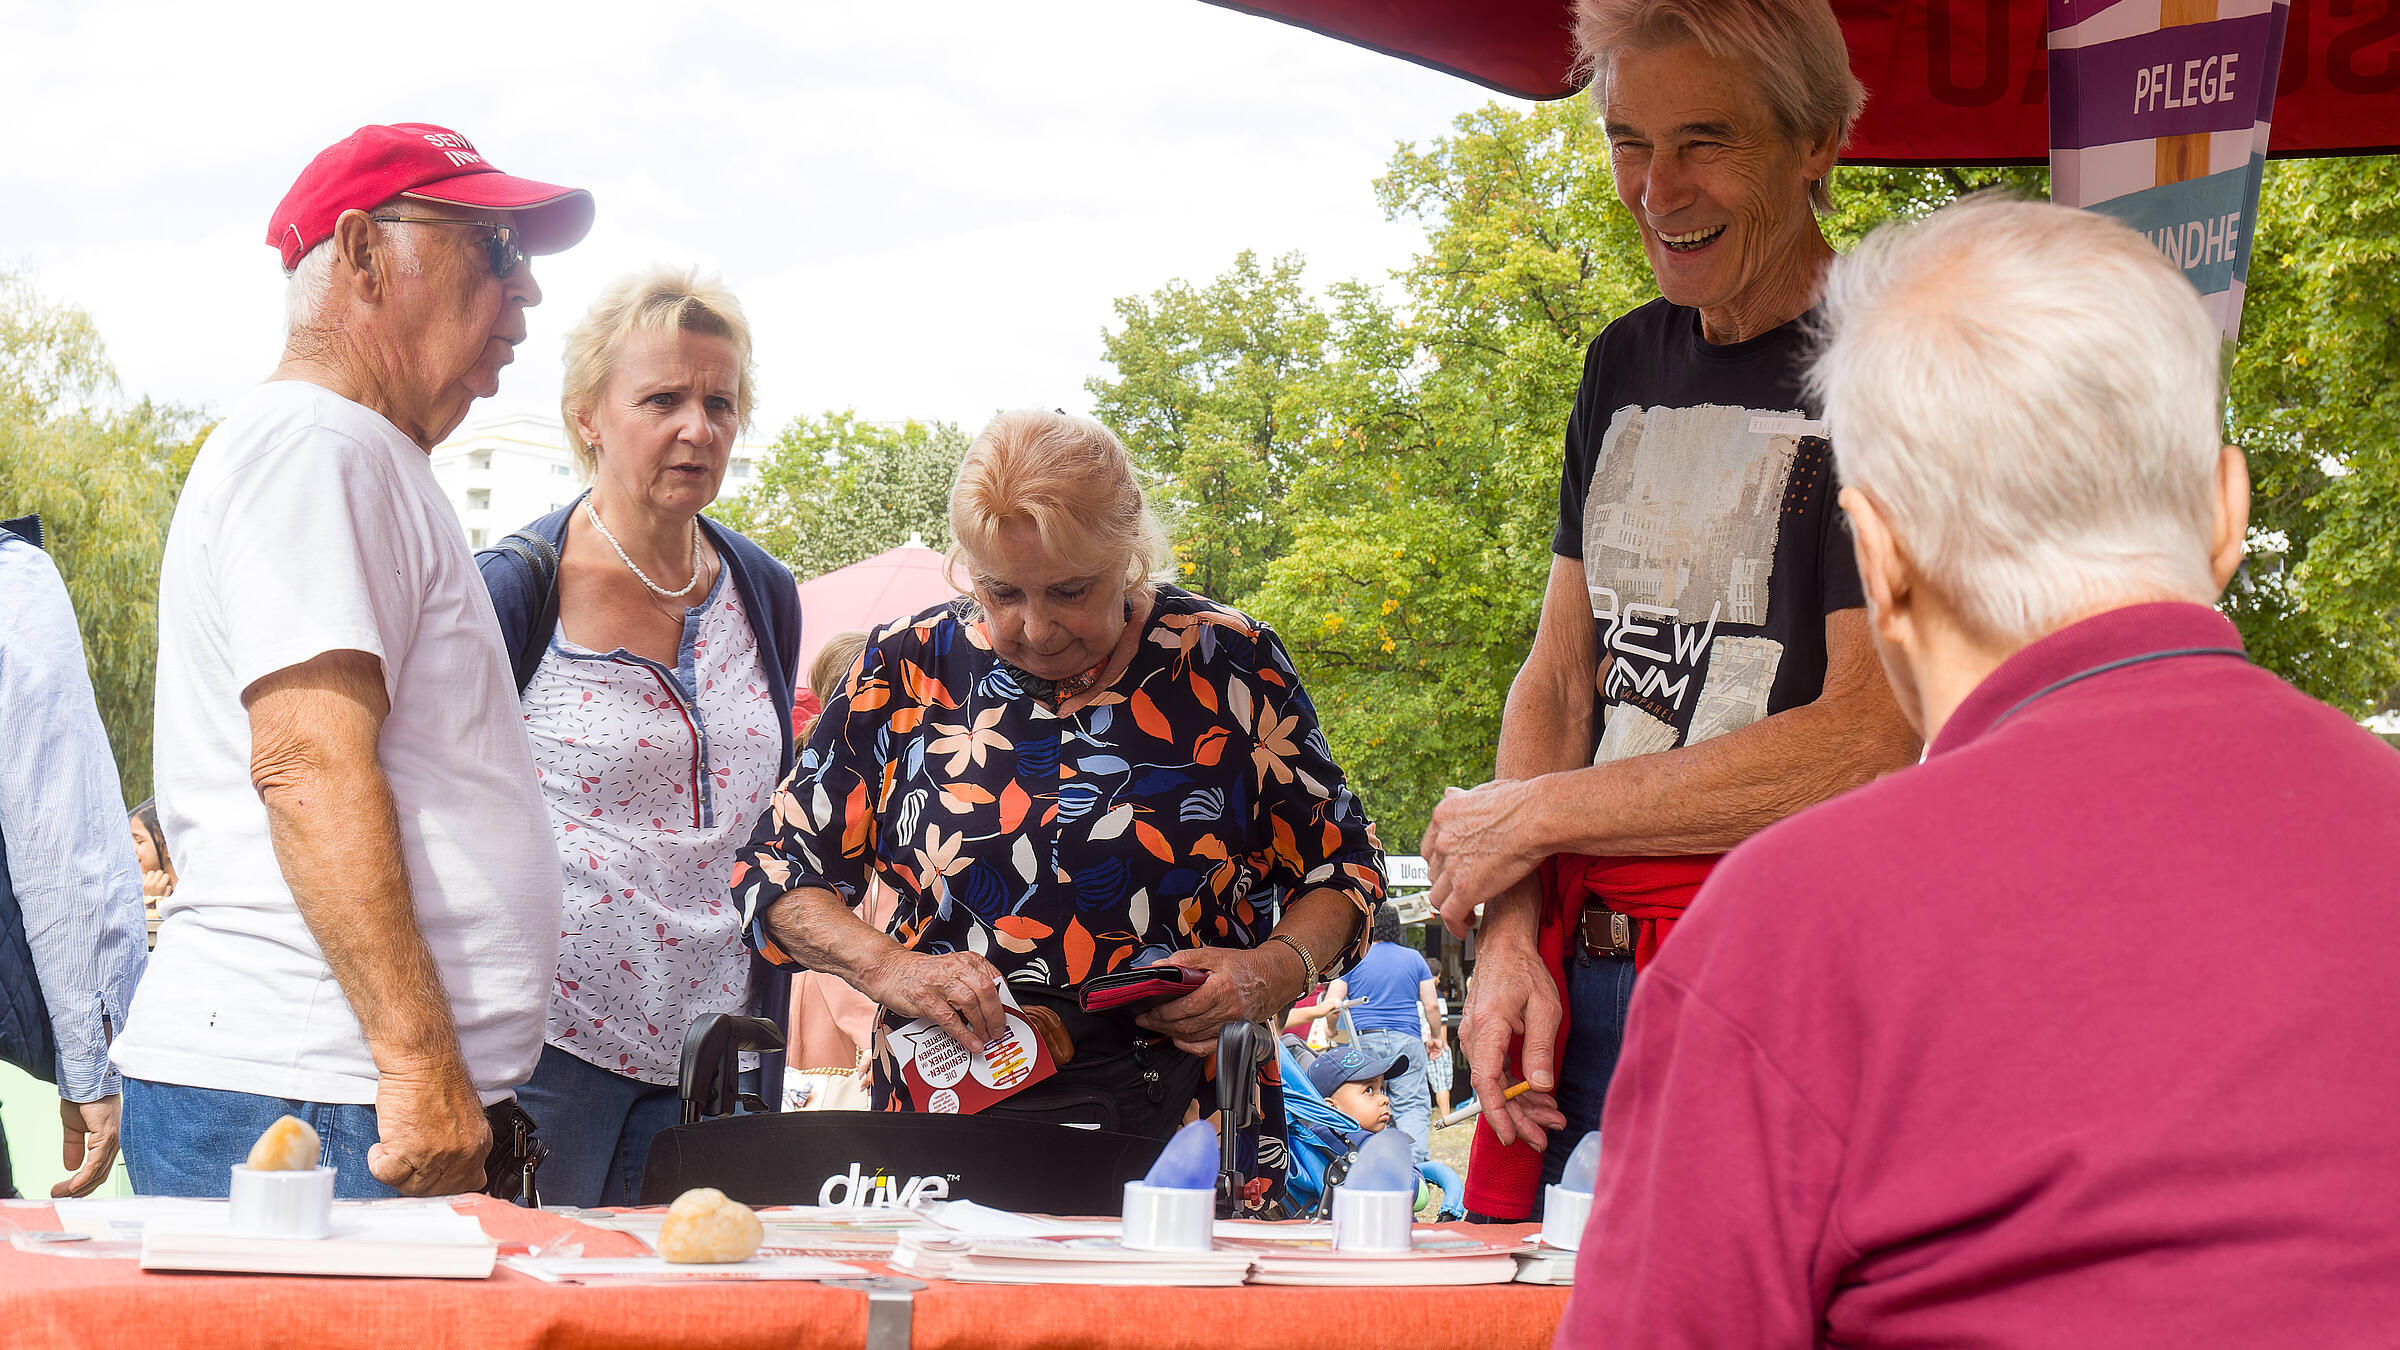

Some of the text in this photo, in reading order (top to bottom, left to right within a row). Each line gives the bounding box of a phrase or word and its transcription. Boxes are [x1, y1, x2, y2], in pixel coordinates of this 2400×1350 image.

[2133, 53, 2239, 115] PFLEGE
[922, 1031, 949, 1048] VIERTEL
[927, 1053, 968, 1078] SENIOREN-
[944, 1070, 957, 1082] DIE
[818, 1162, 950, 1209] drive
